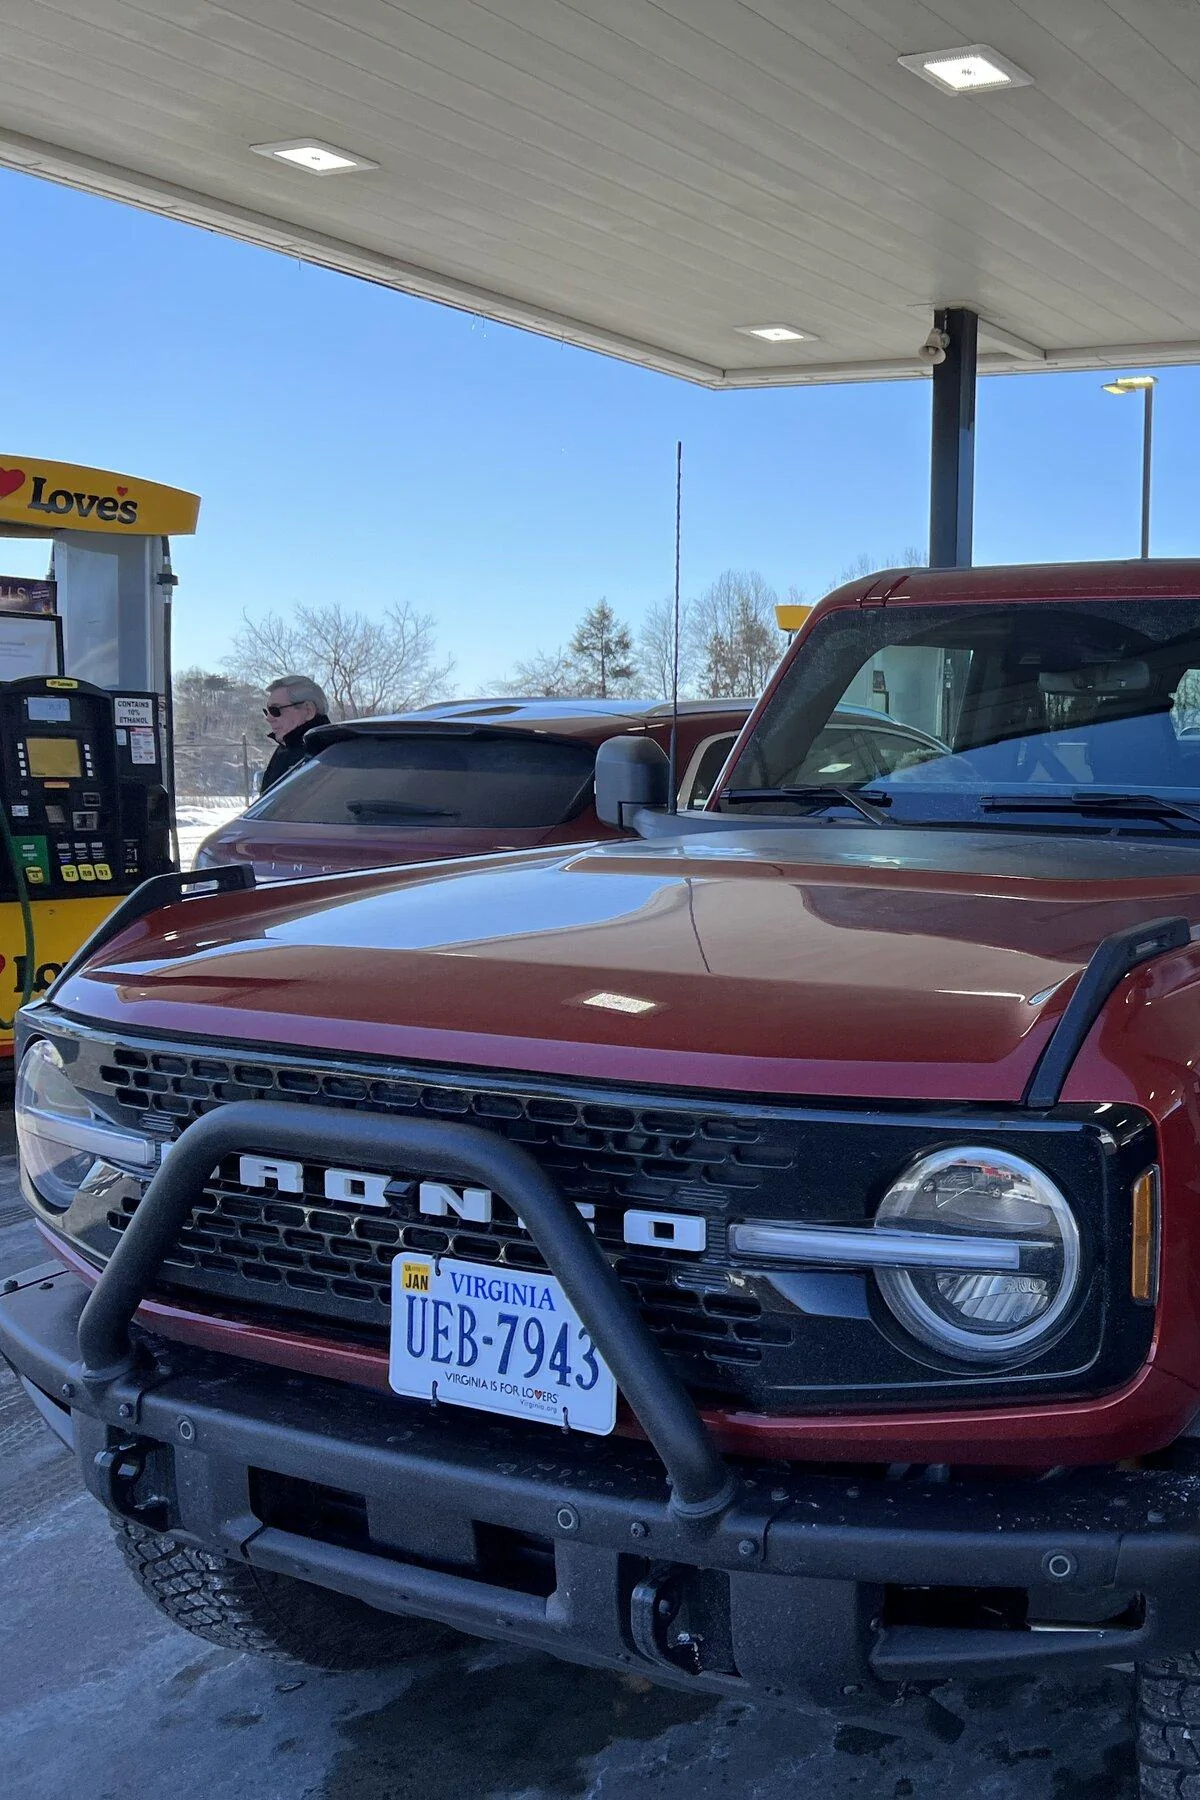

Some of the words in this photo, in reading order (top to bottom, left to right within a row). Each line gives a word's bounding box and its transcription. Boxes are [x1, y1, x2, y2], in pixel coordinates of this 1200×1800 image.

[118, 700, 149, 709] CONTAINS
[120, 716, 149, 725] ETHANOL
[405, 1273, 429, 1290] JAN
[449, 1271, 556, 1312] VIRGINIA
[405, 1294, 600, 1391] UEB-7943
[445, 1371, 488, 1389] VIRGINIA
[490, 1380, 498, 1392] IS
[500, 1383, 520, 1396] FOR
